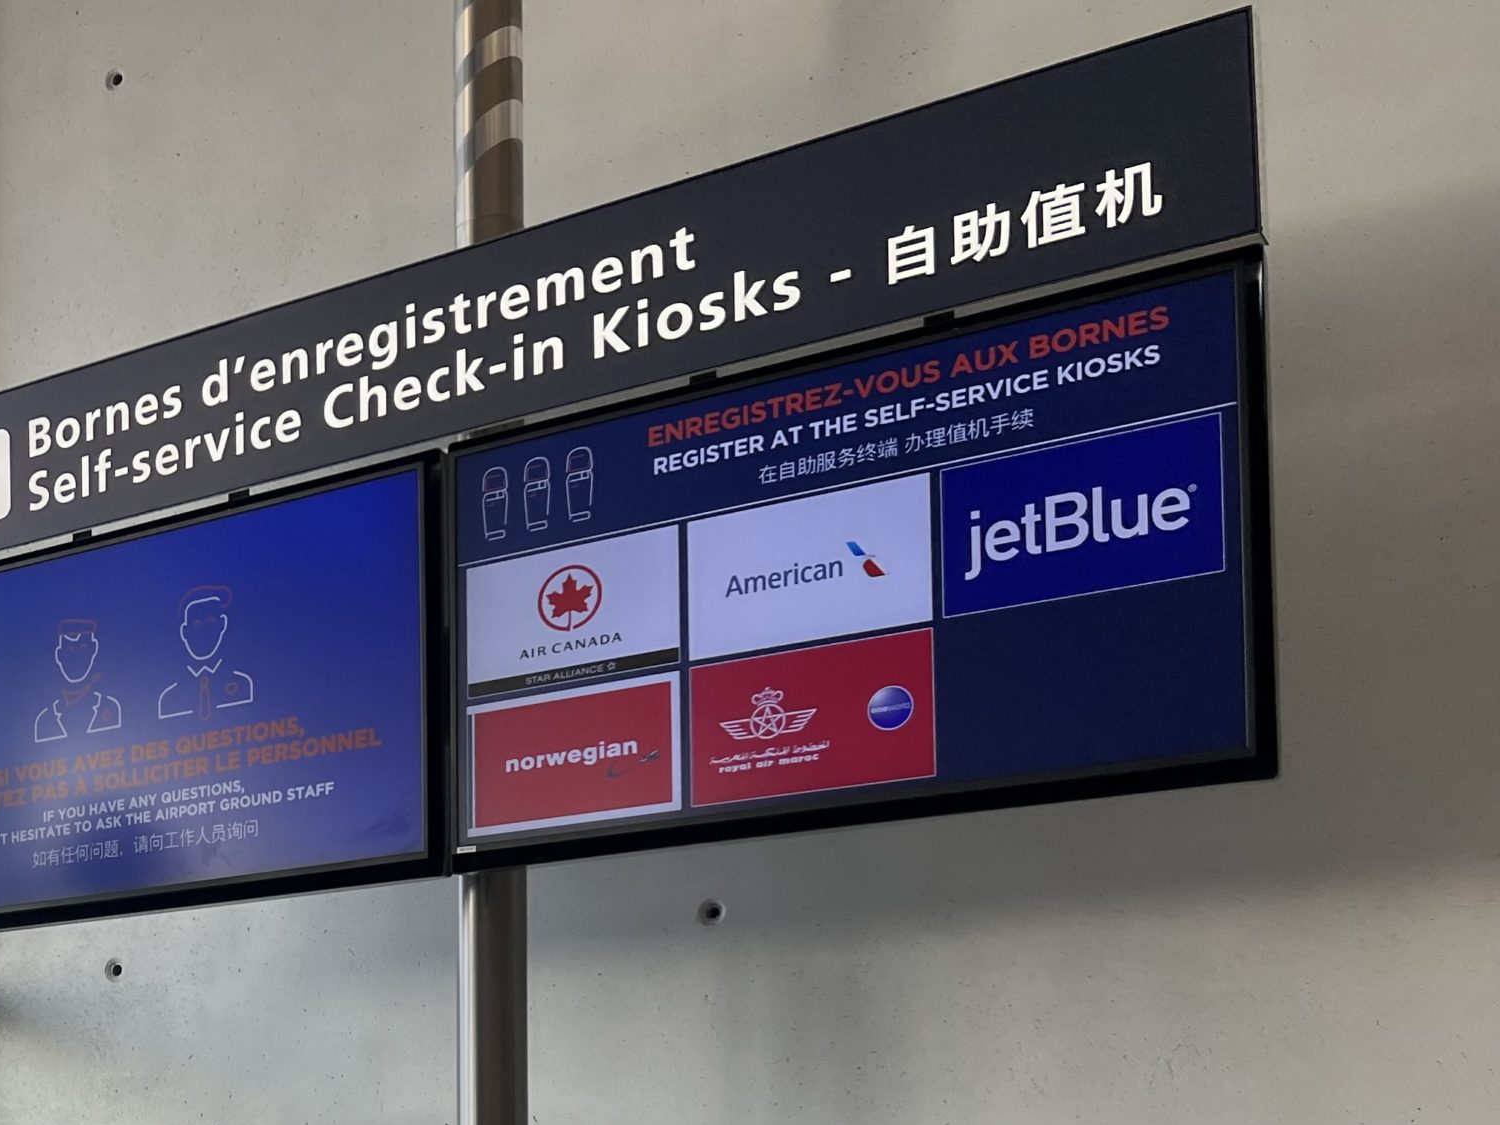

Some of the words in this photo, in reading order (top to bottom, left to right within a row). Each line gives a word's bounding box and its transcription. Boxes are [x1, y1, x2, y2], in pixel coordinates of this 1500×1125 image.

[885, 161, 1163, 286] 自助值机
[27, 409, 302, 513] Self-service
[322, 333, 565, 430] Check-in
[592, 264, 802, 360] Kiosks
[647, 360, 941, 448] ENREGISTREZ-VOUS
[950, 341, 1019, 378] AUX
[1028, 305, 1170, 360] BORNES
[652, 431, 765, 475] REGISTER
[771, 421, 807, 450] AT
[809, 411, 857, 442] THE
[864, 370, 1050, 428] SELF-SERVICE
[1056, 344, 1162, 385] KIOSKS
[27, 382, 182, 459] Bornes
[758, 437, 899, 485] 在自助服务终端
[904, 407, 1035, 454] 办理值机手续
[725, 559, 843, 598] American
[520, 646, 547, 660] AIR
[552, 632, 622, 653] CANADA
[525, 674, 551, 685] STAR
[553, 664, 604, 680] ALLIANCE
[16, 761, 67, 784] VOUS
[73, 752, 125, 774] AVEZ
[130, 743, 170, 765] DES
[176, 716, 305, 757] QUESTIONS,
[32, 781, 68, 803] PAS
[93, 757, 210, 792] SOLLICITER
[216, 754, 241, 773] LE
[247, 727, 382, 768] PERSONNEL
[505, 737, 638, 773] norwegian
[719, 762, 751, 774] royal
[756, 760, 774, 769] air
[779, 754, 820, 766] maroc
[11, 823, 71, 843] HESITATE
[74, 819, 93, 834] TO
[95, 814, 123, 830] ASK
[125, 810, 152, 825] THE
[155, 800, 216, 821] AIRPORT
[220, 790, 283, 813] GROUND
[286, 781, 335, 802] STAFF
[43, 810, 54, 823] IF
[57, 805, 86, 821] YOU
[89, 799, 126, 817] HAVE
[129, 795, 158, 811] ANY
[161, 779, 245, 805] QUESTIONS,
